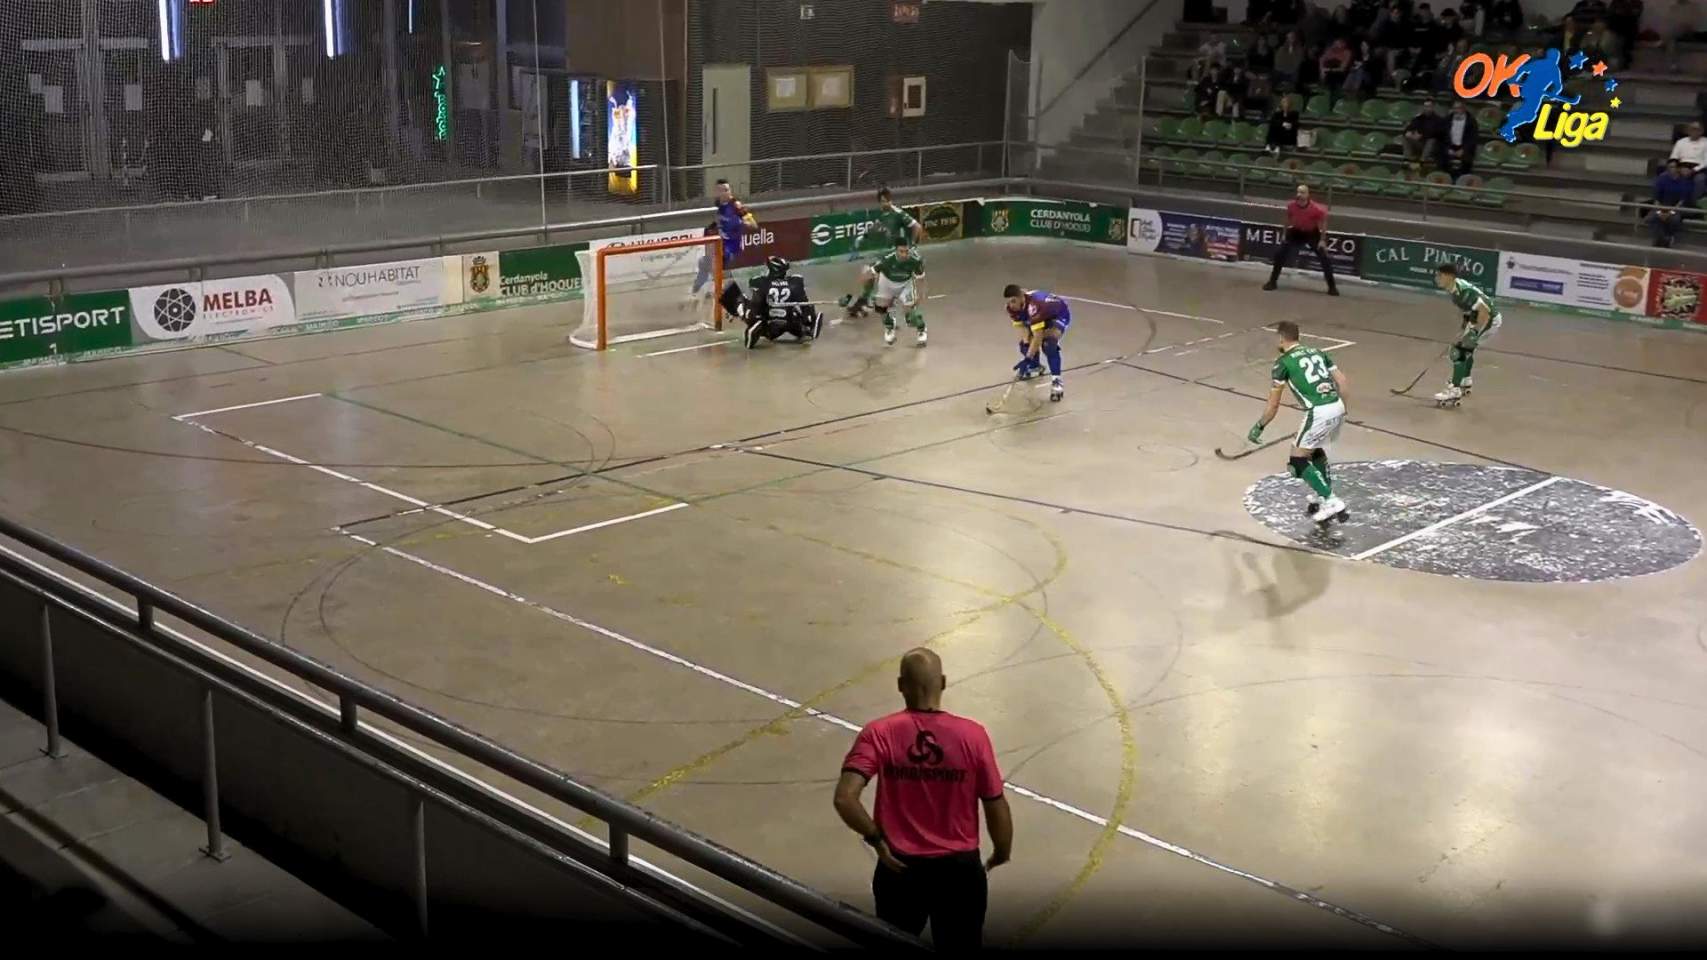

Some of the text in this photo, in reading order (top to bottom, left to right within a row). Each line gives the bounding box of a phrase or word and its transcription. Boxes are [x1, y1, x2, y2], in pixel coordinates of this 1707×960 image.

[1030, 209, 1091, 223] CERDANYOLA
[1030, 219, 1053, 230] CLUB
[1376, 247, 1410, 263] CAL
[1424, 247, 1485, 275] PINTXO
[335, 266, 421, 287] NOUHABITAT
[500, 271, 549, 286] Cerdanyola
[203, 288, 273, 312] MELBA
[500, 285, 529, 297] CLUB
[768, 287, 791, 304] 32
[0, 306, 126, 340] ETISPORT
[1299, 354, 1329, 384] 23
